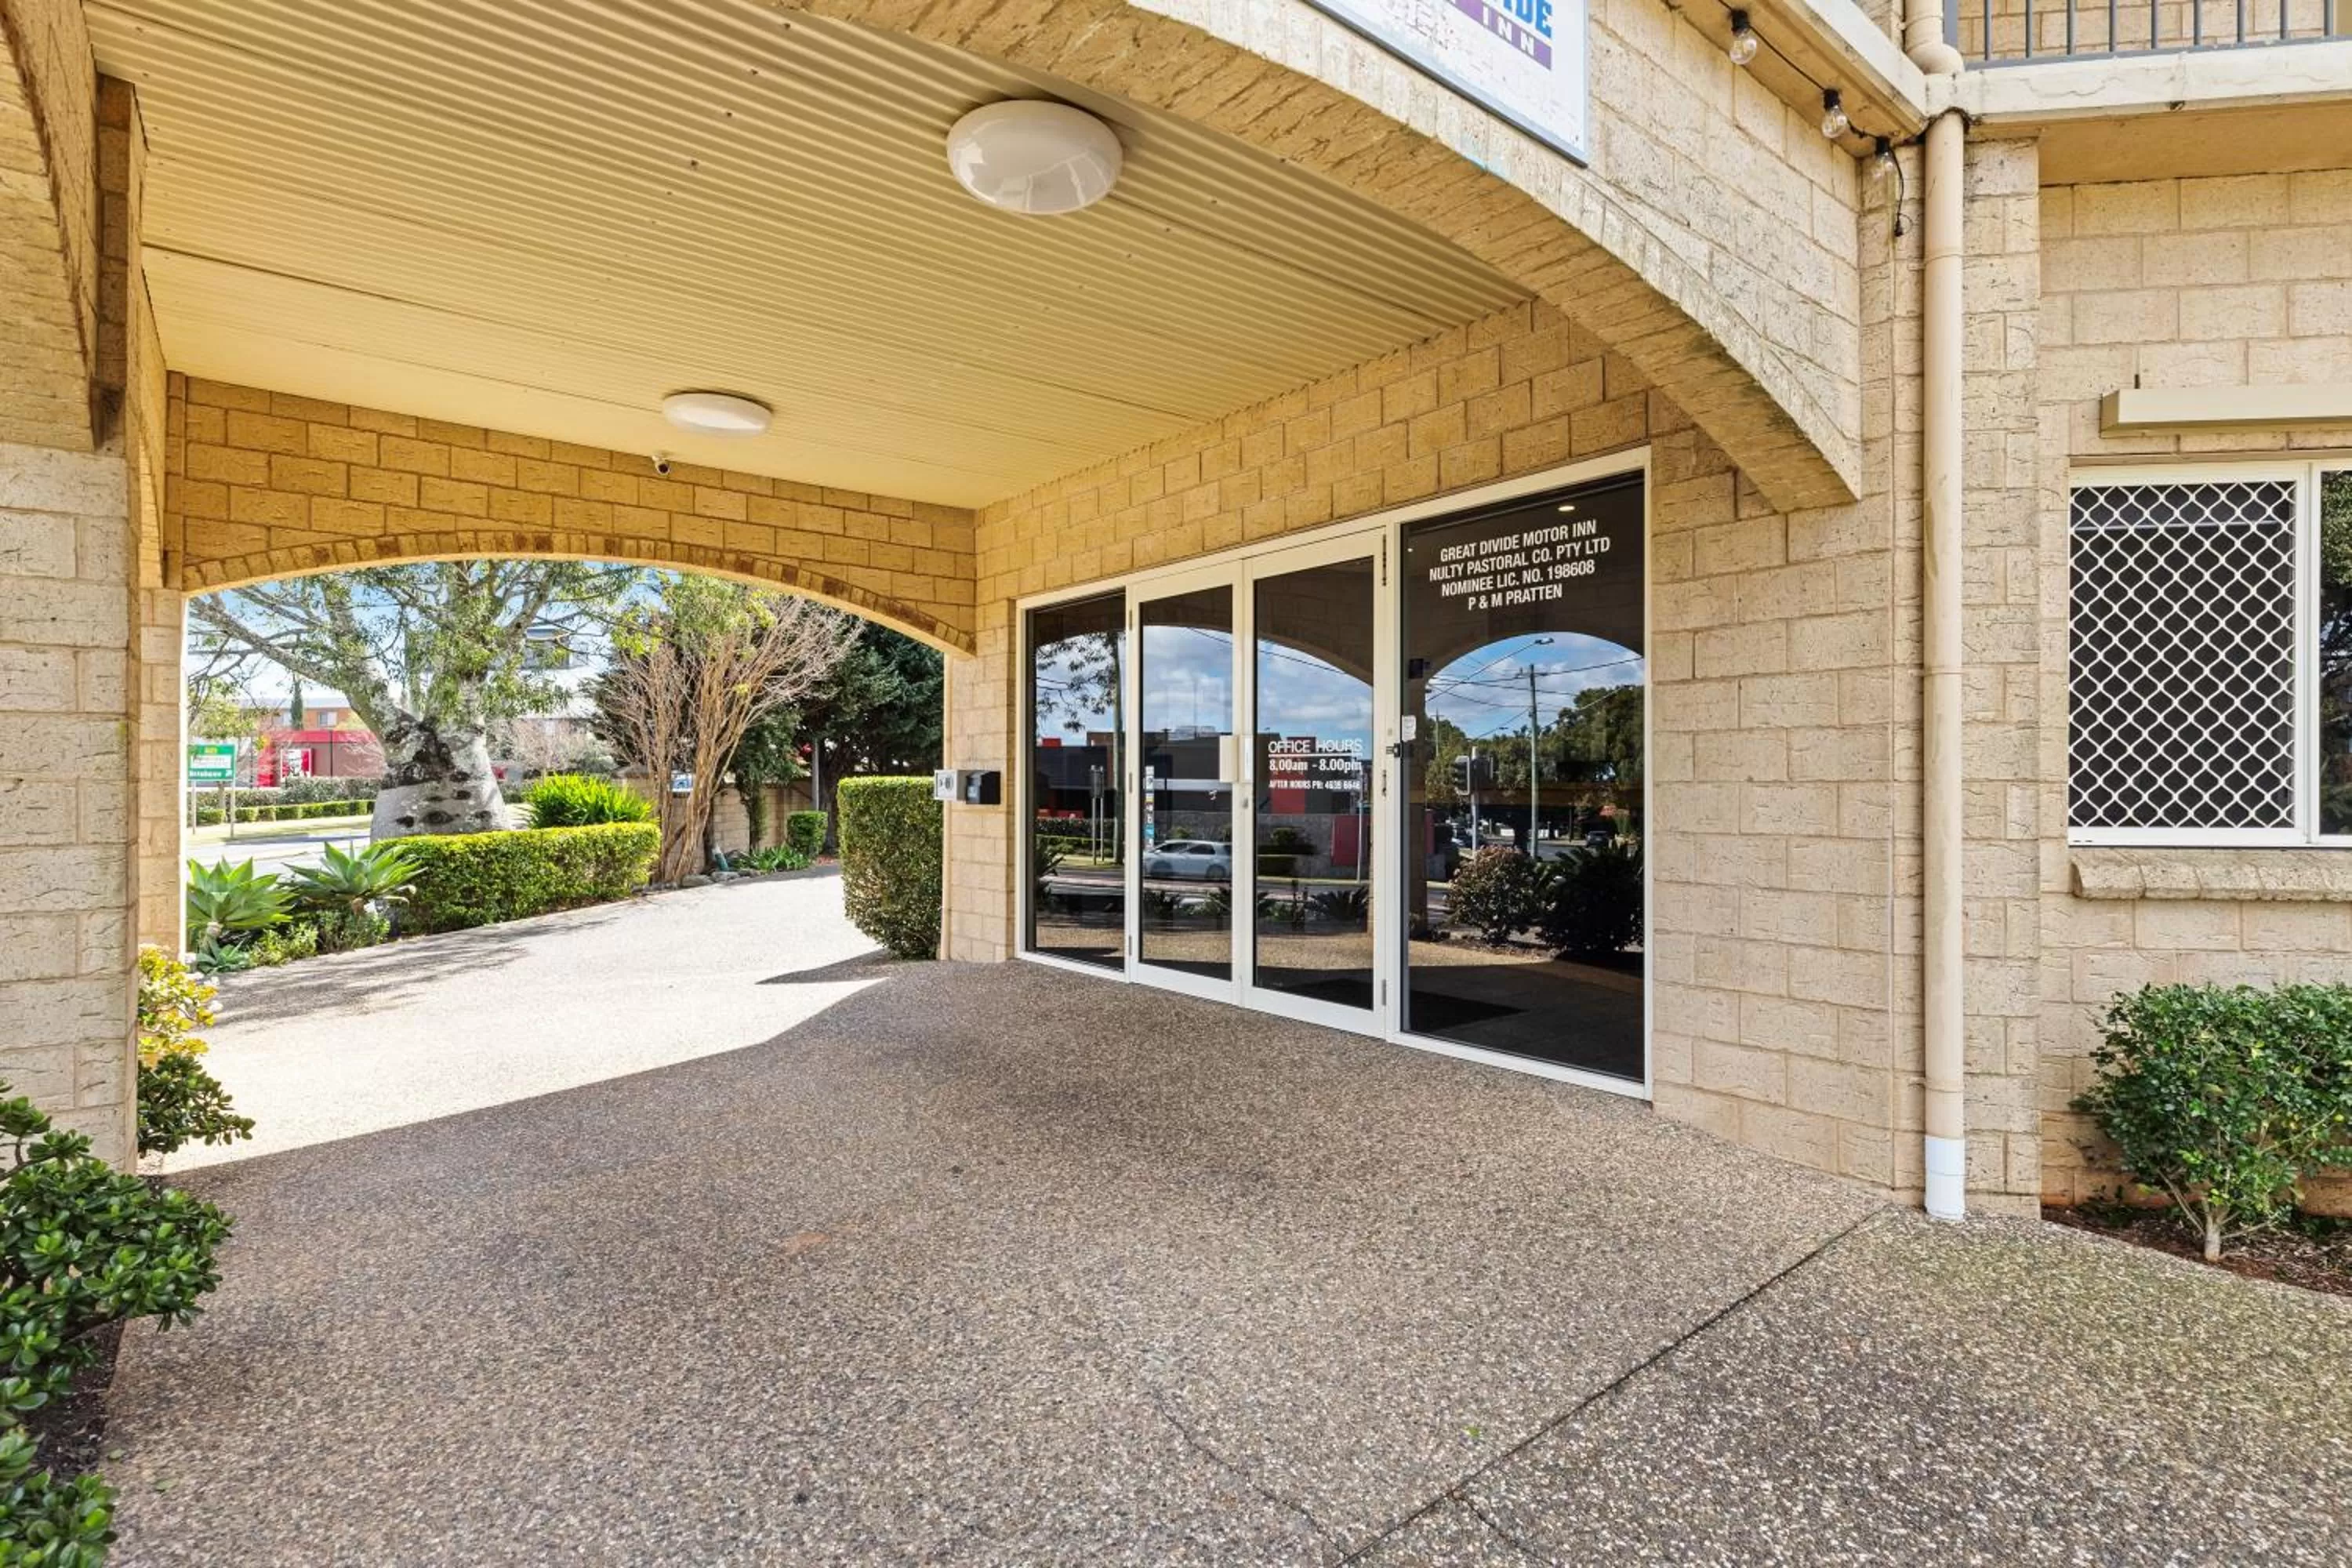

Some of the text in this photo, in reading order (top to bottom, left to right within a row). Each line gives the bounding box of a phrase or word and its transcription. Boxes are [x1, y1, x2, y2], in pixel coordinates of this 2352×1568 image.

[1483, 5, 1535, 56] INN
[1440, 519, 1597, 562] GREAT DIVIDE MOTOR INN
[1429, 536, 1611, 582] NULTY PASTORAL CO. PTY LTD
[1442, 559, 1595, 597] NOMINEE LIC. NO. 198608
[1468, 583, 1563, 611] P & M PRATTEN
[1269, 739, 1363, 753] OFFICE HOURS
[1269, 758, 1308, 771] 8.00am
[1319, 758, 1362, 773] 8.00pm
[1269, 779, 1287, 789] AFTER
[1289, 779, 1311, 789] HOURS
